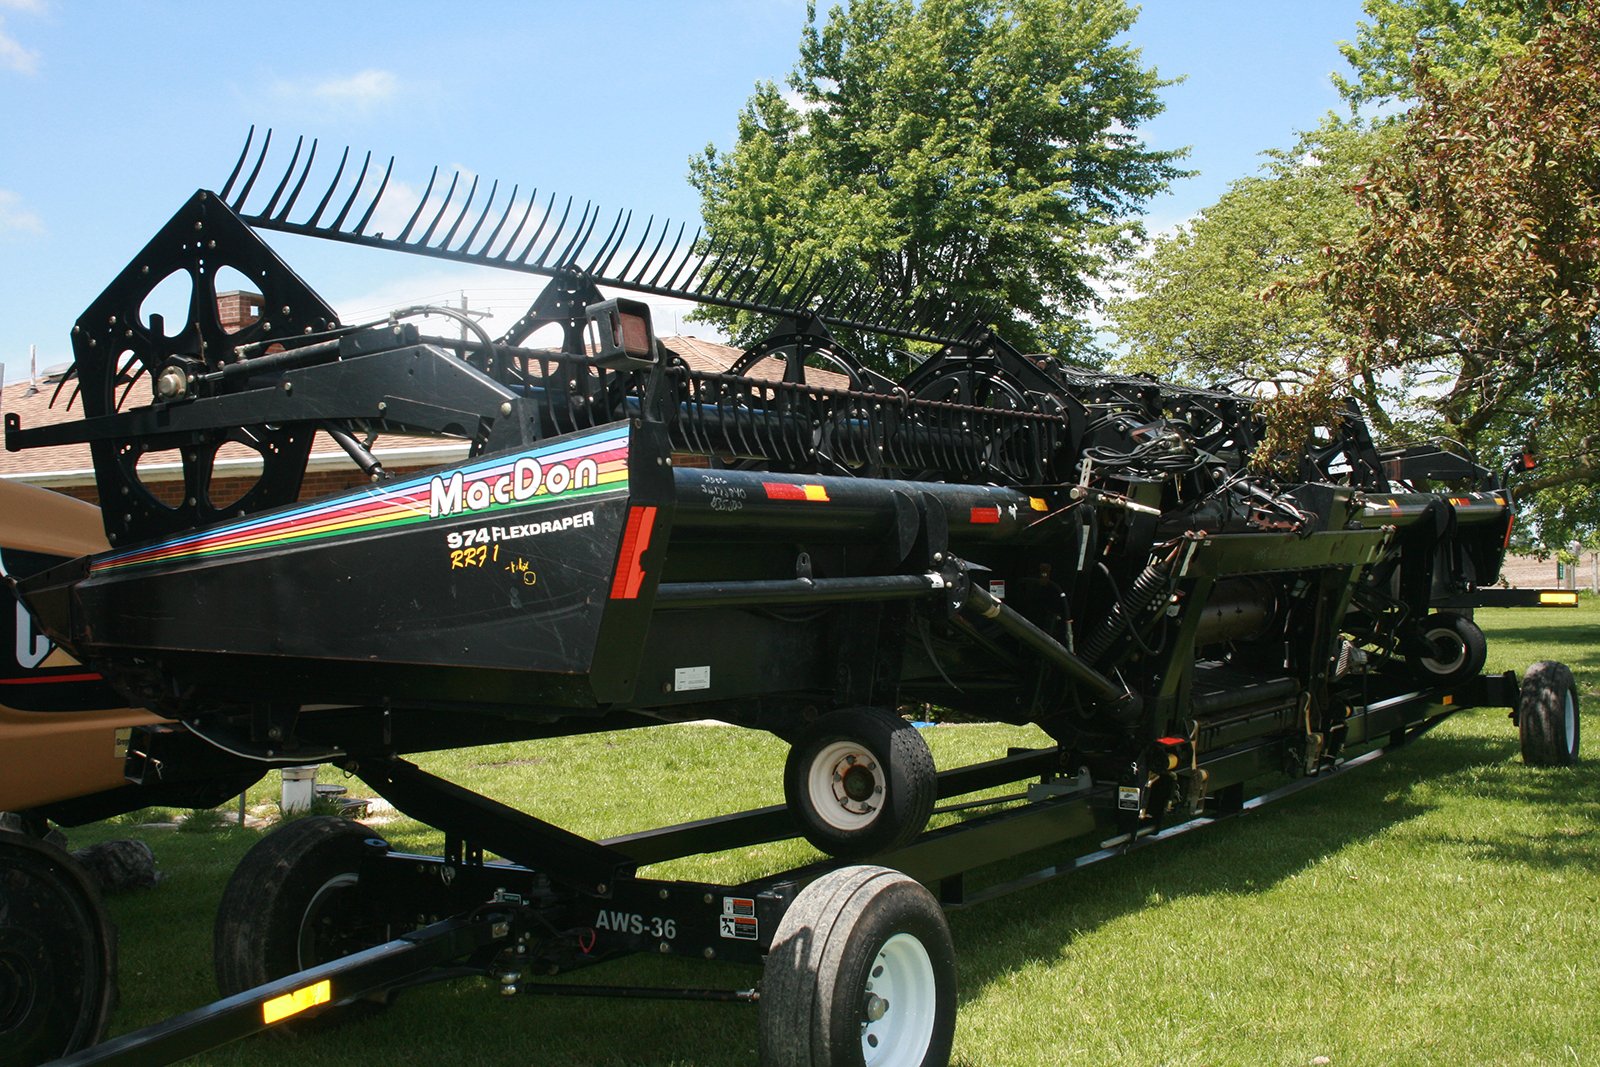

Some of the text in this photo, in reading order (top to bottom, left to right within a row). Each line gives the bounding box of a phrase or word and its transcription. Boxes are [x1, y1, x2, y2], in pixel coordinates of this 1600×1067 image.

[429, 456, 599, 518] MacDon
[447, 510, 595, 549] 974 FLEXDRAPER
[595, 909, 677, 940] AWS-36
